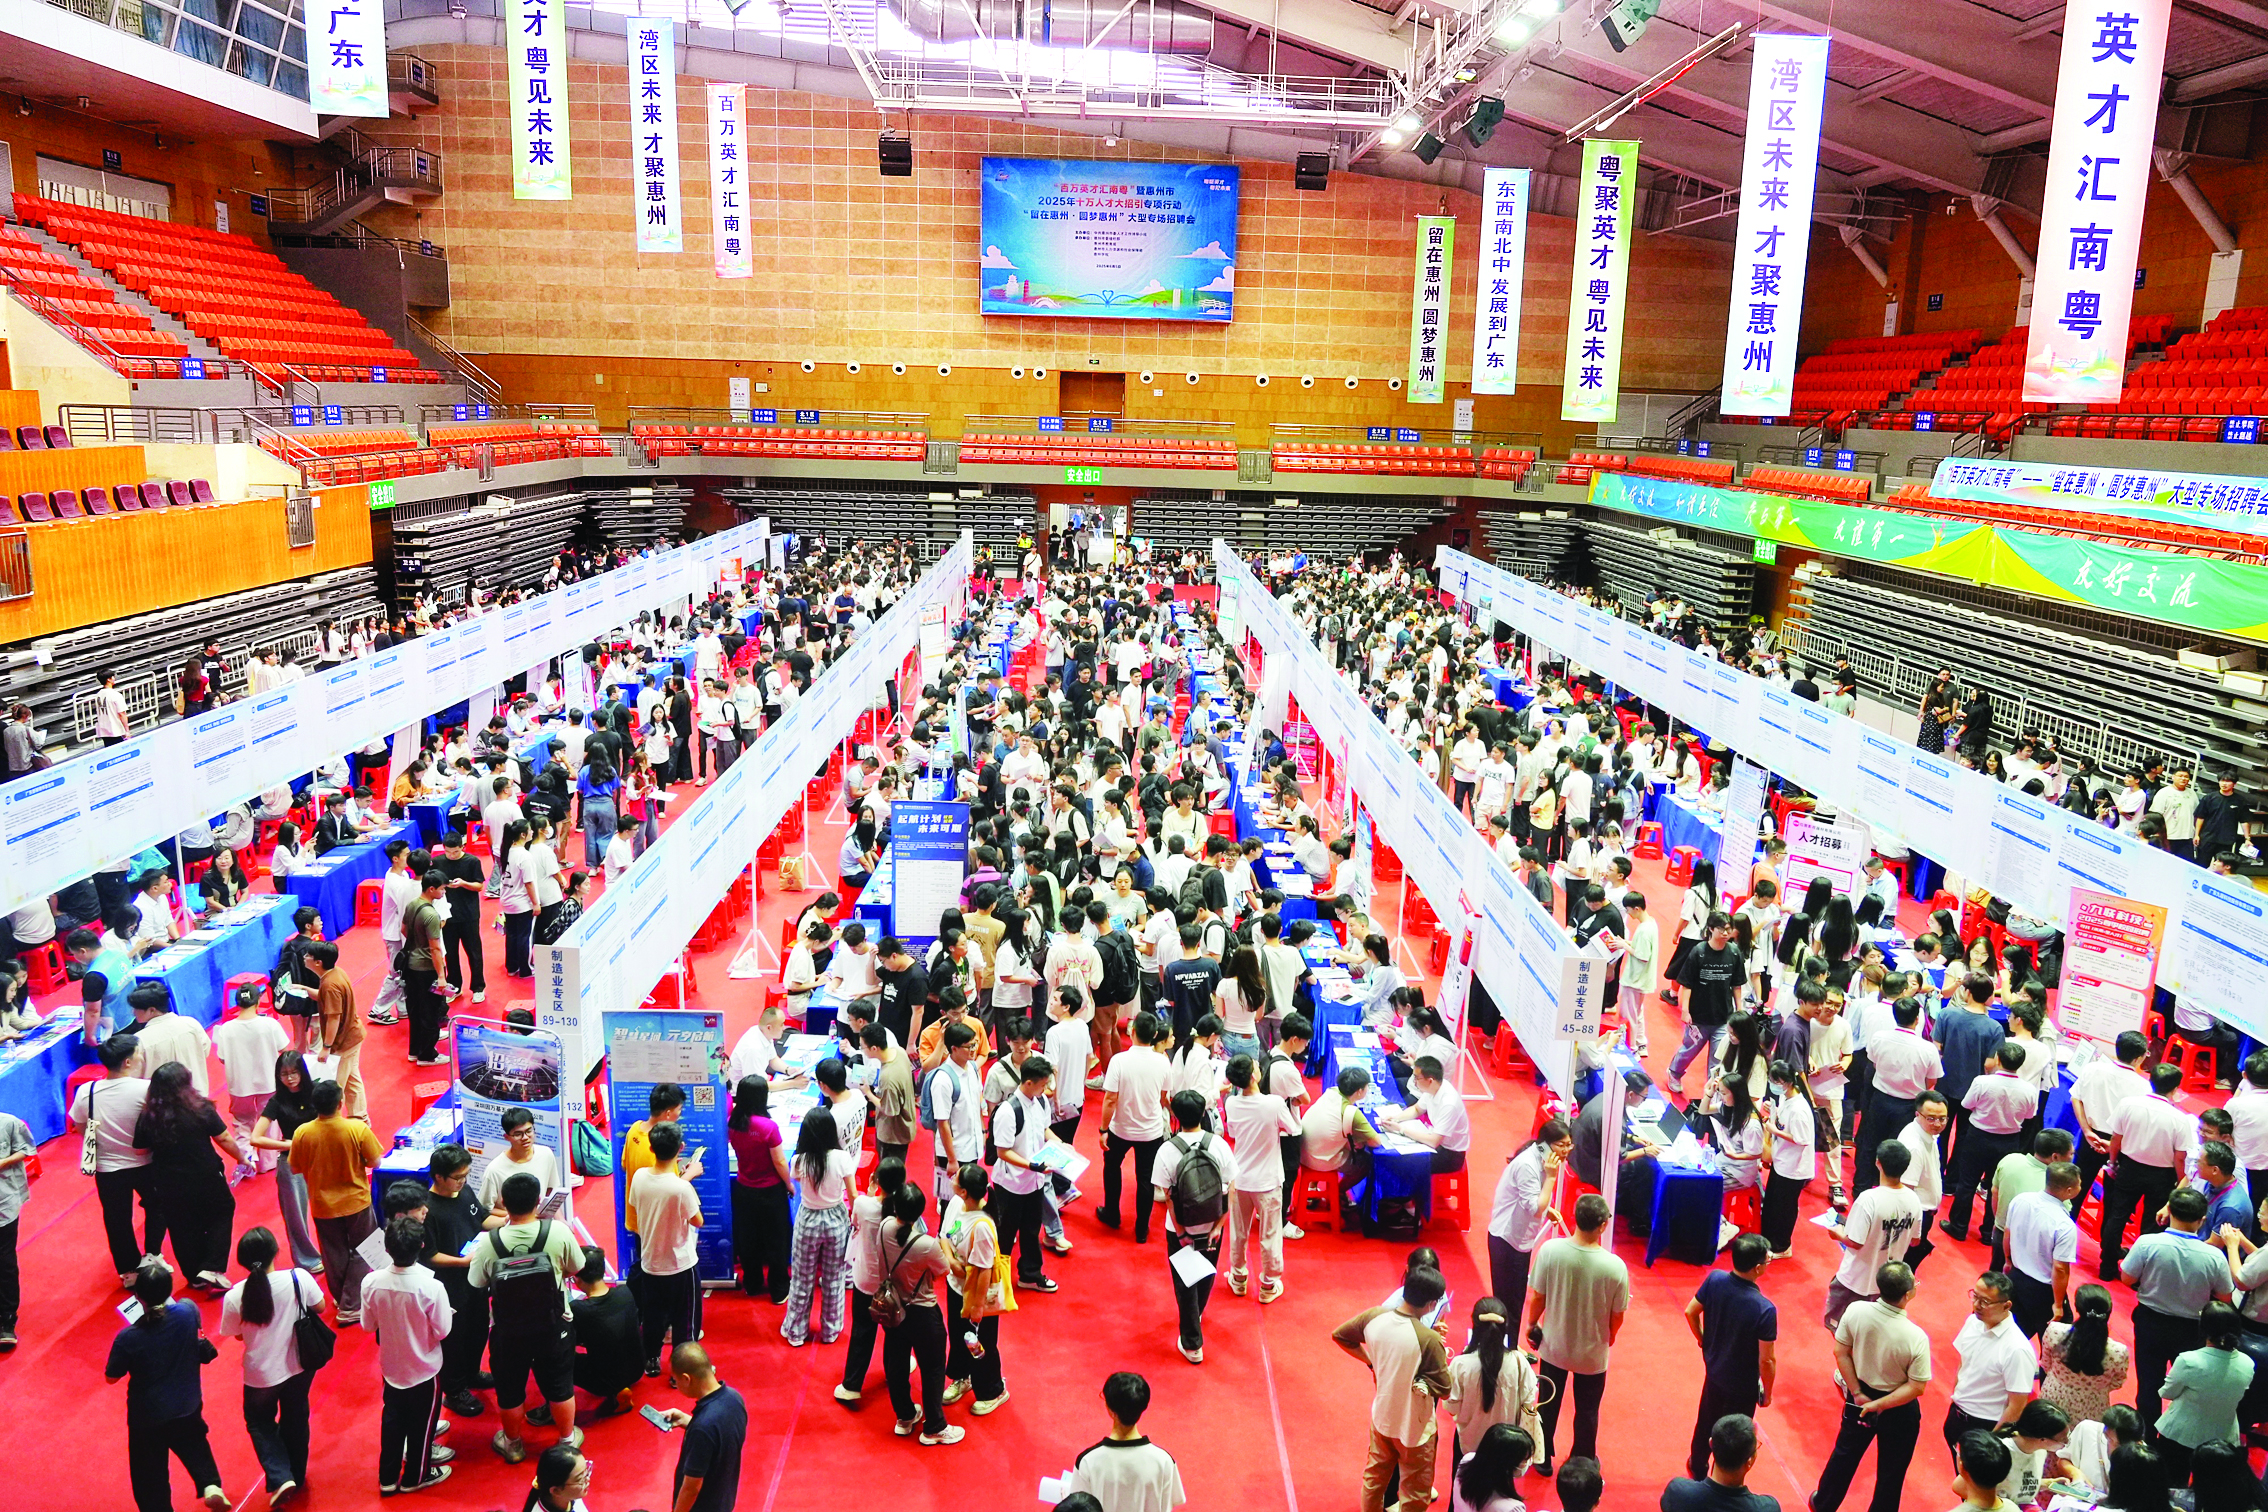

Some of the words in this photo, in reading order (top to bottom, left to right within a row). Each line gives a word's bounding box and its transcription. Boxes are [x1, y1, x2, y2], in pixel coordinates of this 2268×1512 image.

[328, 0, 364, 68] 广东
[523, 0, 548, 36] 才
[524, 46, 554, 165] 粤见未来
[639, 29, 662, 124] 湾区未来
[1763, 58, 1802, 212] 湾区未来
[643, 132, 666, 226] 才聚惠州
[719, 95, 740, 256] 百万英才汇南粤
[1038, 196, 1182, 210] 2025年十万人才大招引专项行动
[2058, 11, 2139, 340] 英才汇南粤
[1492, 181, 1515, 273] 东西南北中
[1590, 155, 1622, 270] 粤聚英才
[1424, 227, 1444, 303] 留在惠州
[1486, 278, 1509, 368] 发展到广东
[1743, 224, 1787, 373] 才聚惠州
[1418, 308, 1438, 382] 圆梦惠州
[1579, 278, 1612, 390] 粤见未来
[372, 484, 394, 506] 安全出口
[1066, 468, 1101, 483] 安全出口
[1755, 541, 1776, 563] 安全出口
[1833, 517, 1904, 550] 友谊第一
[2073, 557, 2198, 608] 友好交流
[897, 814, 942, 824] 起航计划
[917, 824, 963, 833] 未来可期
[1798, 831, 1843, 850] 人才招募
[2089, 903, 2144, 925] 九联科技
[550, 949, 564, 1012] 制造业专区
[1573, 961, 1591, 1020] 制造业专区
[542, 1014, 578, 1027] 89-130
[1562, 1024, 1594, 1034] 45-88
